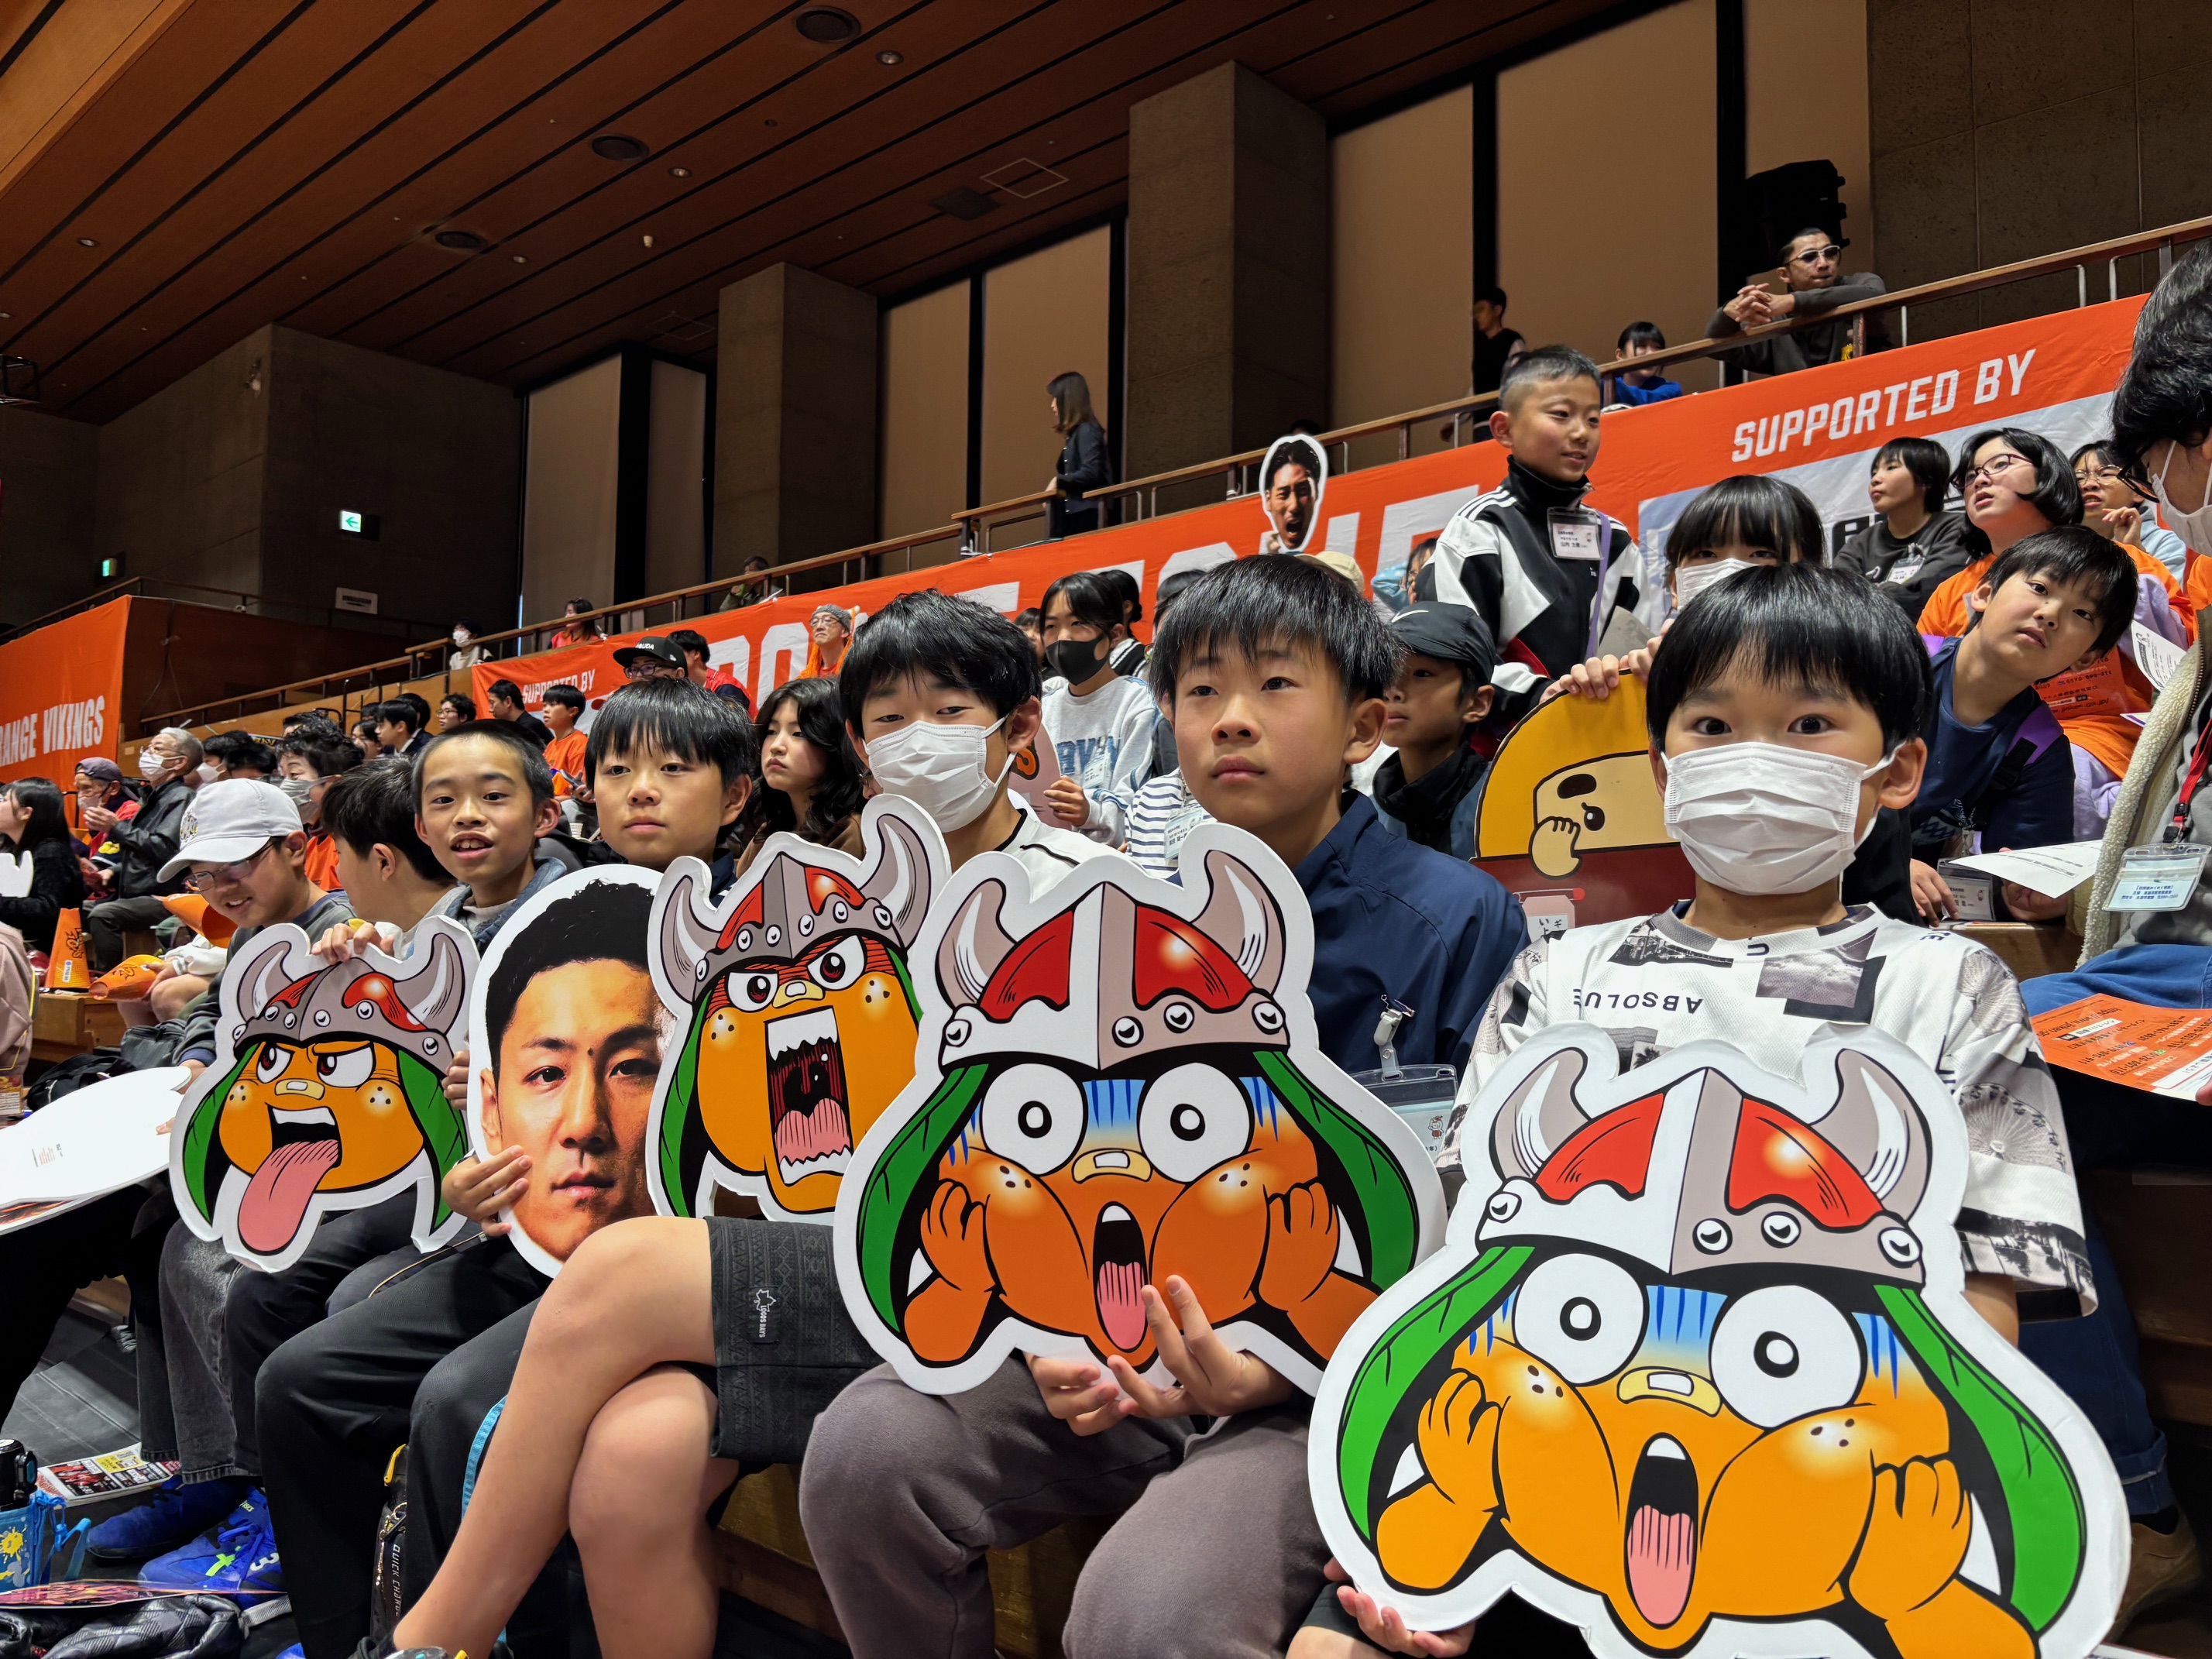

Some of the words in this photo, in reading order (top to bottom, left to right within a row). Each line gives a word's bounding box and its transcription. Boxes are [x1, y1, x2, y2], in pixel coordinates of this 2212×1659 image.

[1732, 369, 1960, 462] SUPPORTED
[1973, 349, 2036, 405] BY
[581, 668, 596, 692] BY
[43, 695, 105, 754] VIKINGS
[1573, 988, 1703, 1015] ABSOLUE
